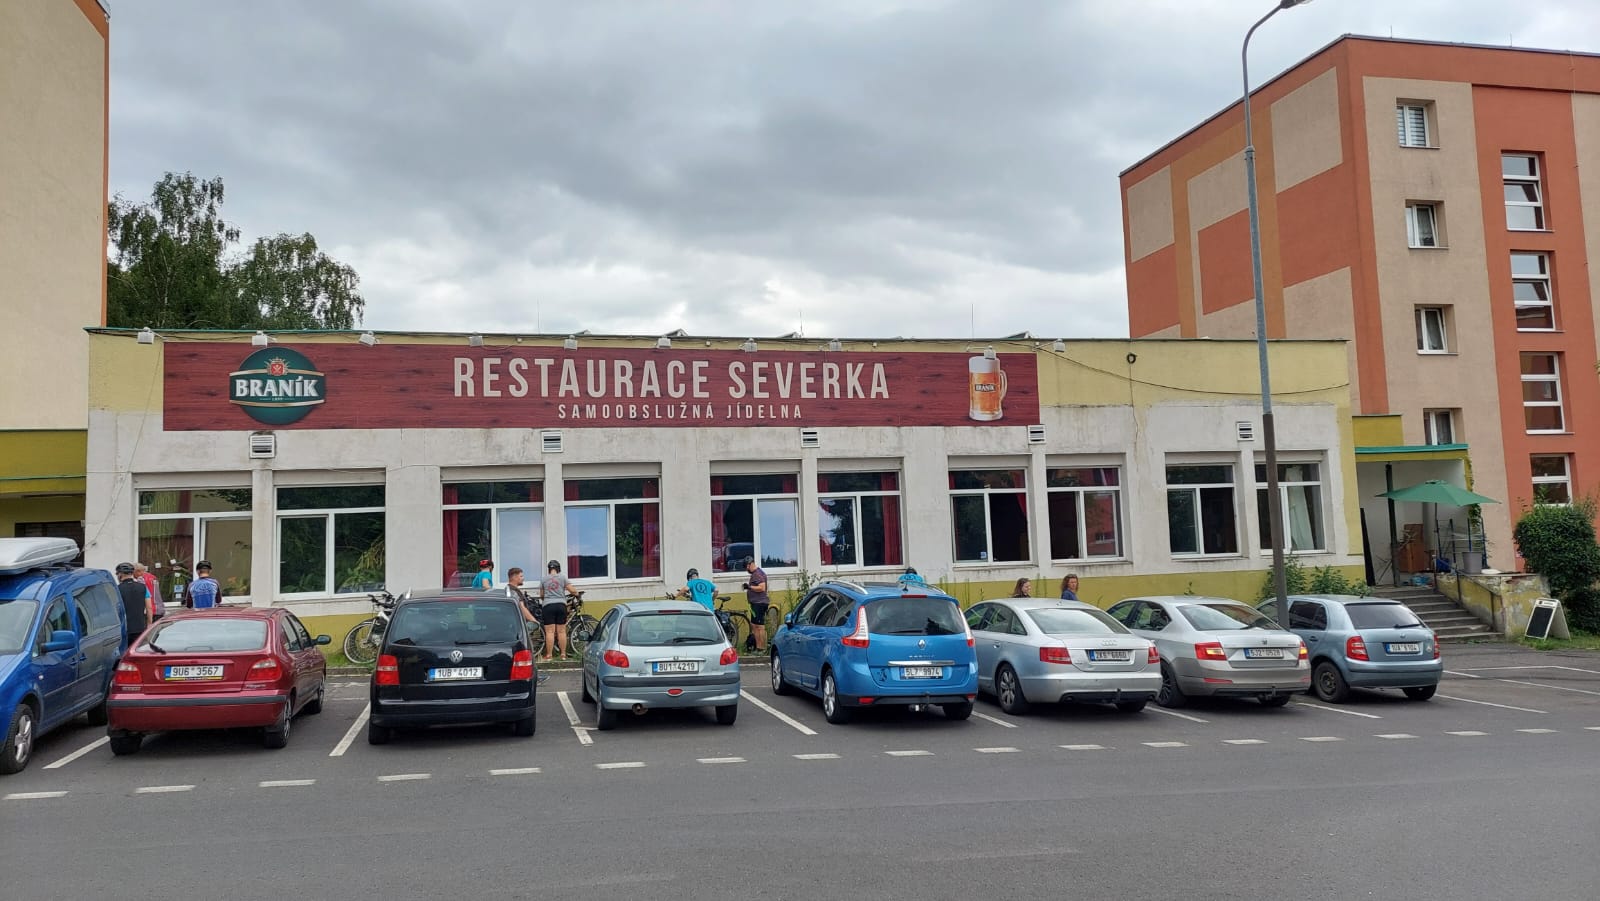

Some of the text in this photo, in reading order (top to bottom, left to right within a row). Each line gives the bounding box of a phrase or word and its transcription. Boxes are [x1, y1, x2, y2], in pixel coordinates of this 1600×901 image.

[454, 357, 890, 399] RESTAURACE SEVERKA
[235, 376, 319, 397] BRANÍK
[558, 402, 802, 419] SAMOOBSLUŽNÁ JÍDELNA
[172, 666, 219, 676] 9U6 3567
[438, 668, 478, 677] 1UB 4012
[677, 662, 695, 671] 4219
